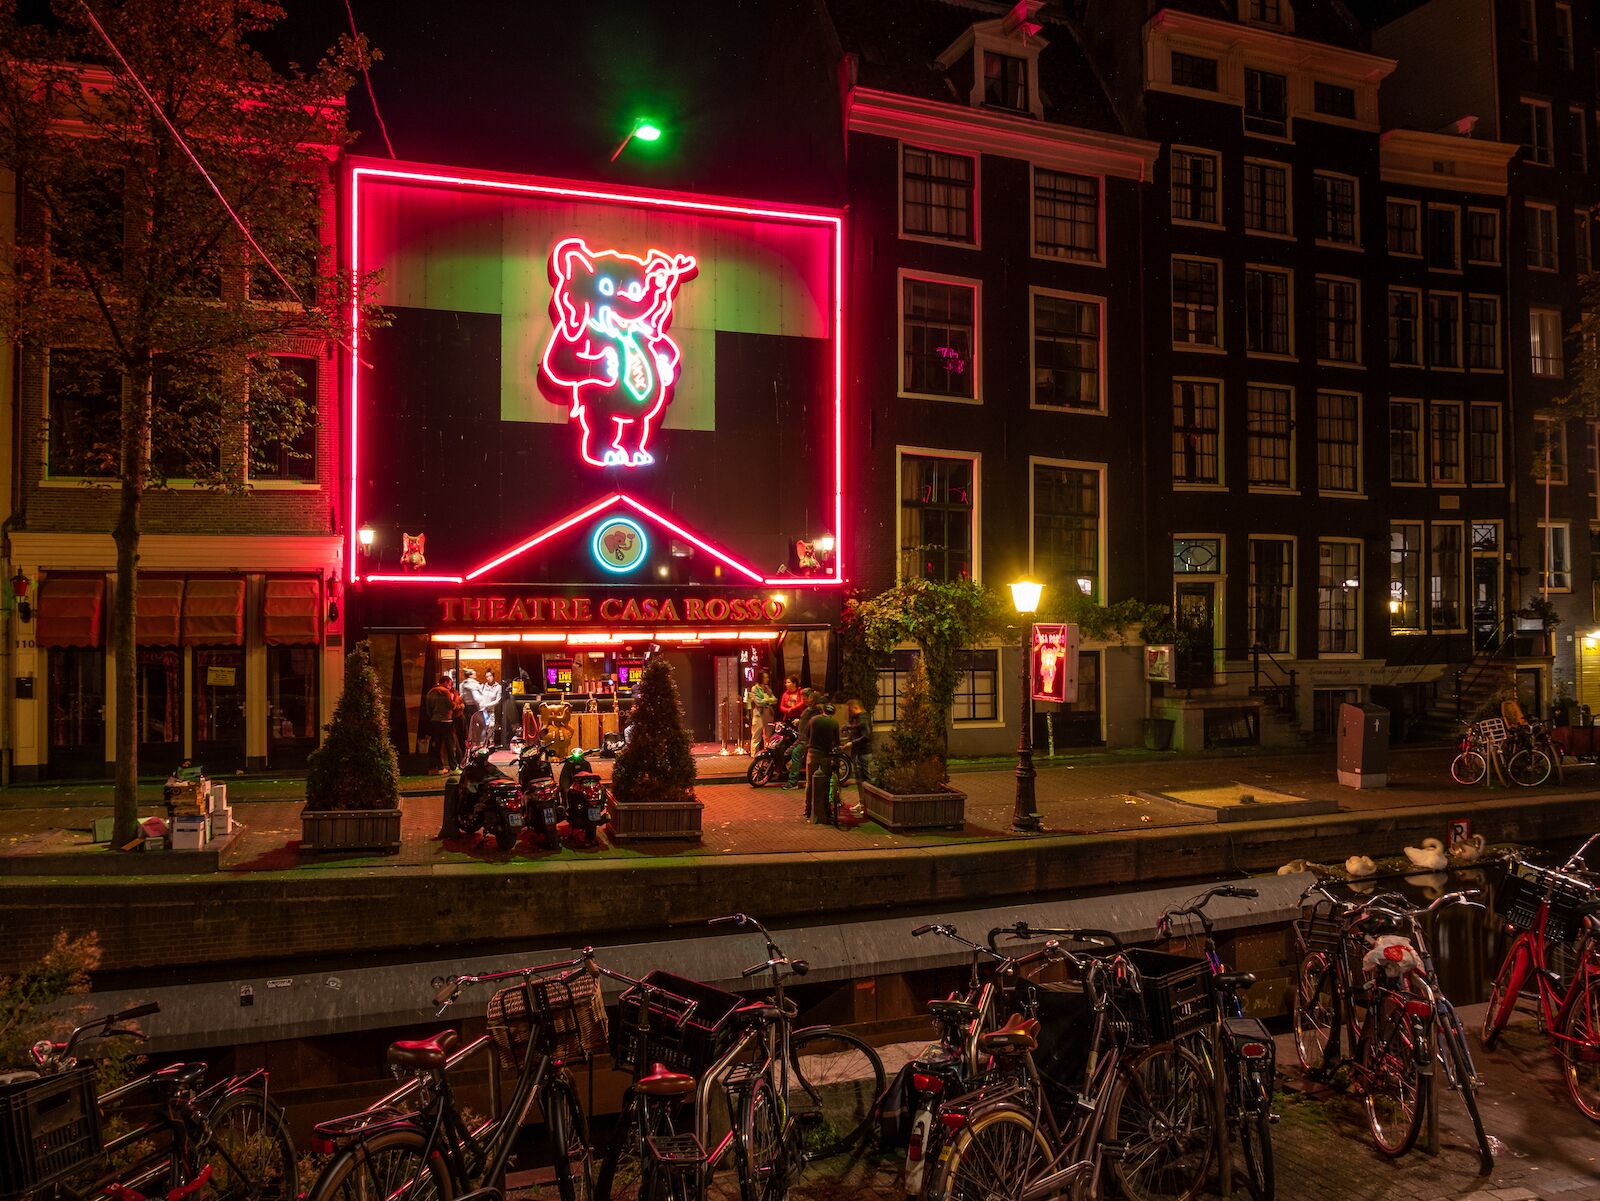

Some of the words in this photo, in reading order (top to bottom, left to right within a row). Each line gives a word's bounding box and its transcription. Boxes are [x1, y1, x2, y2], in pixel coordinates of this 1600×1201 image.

[438, 597, 593, 621] THEATRE
[600, 598, 680, 621] CASA
[683, 598, 785, 621] ROSSO
[15, 639, 35, 649] 110
